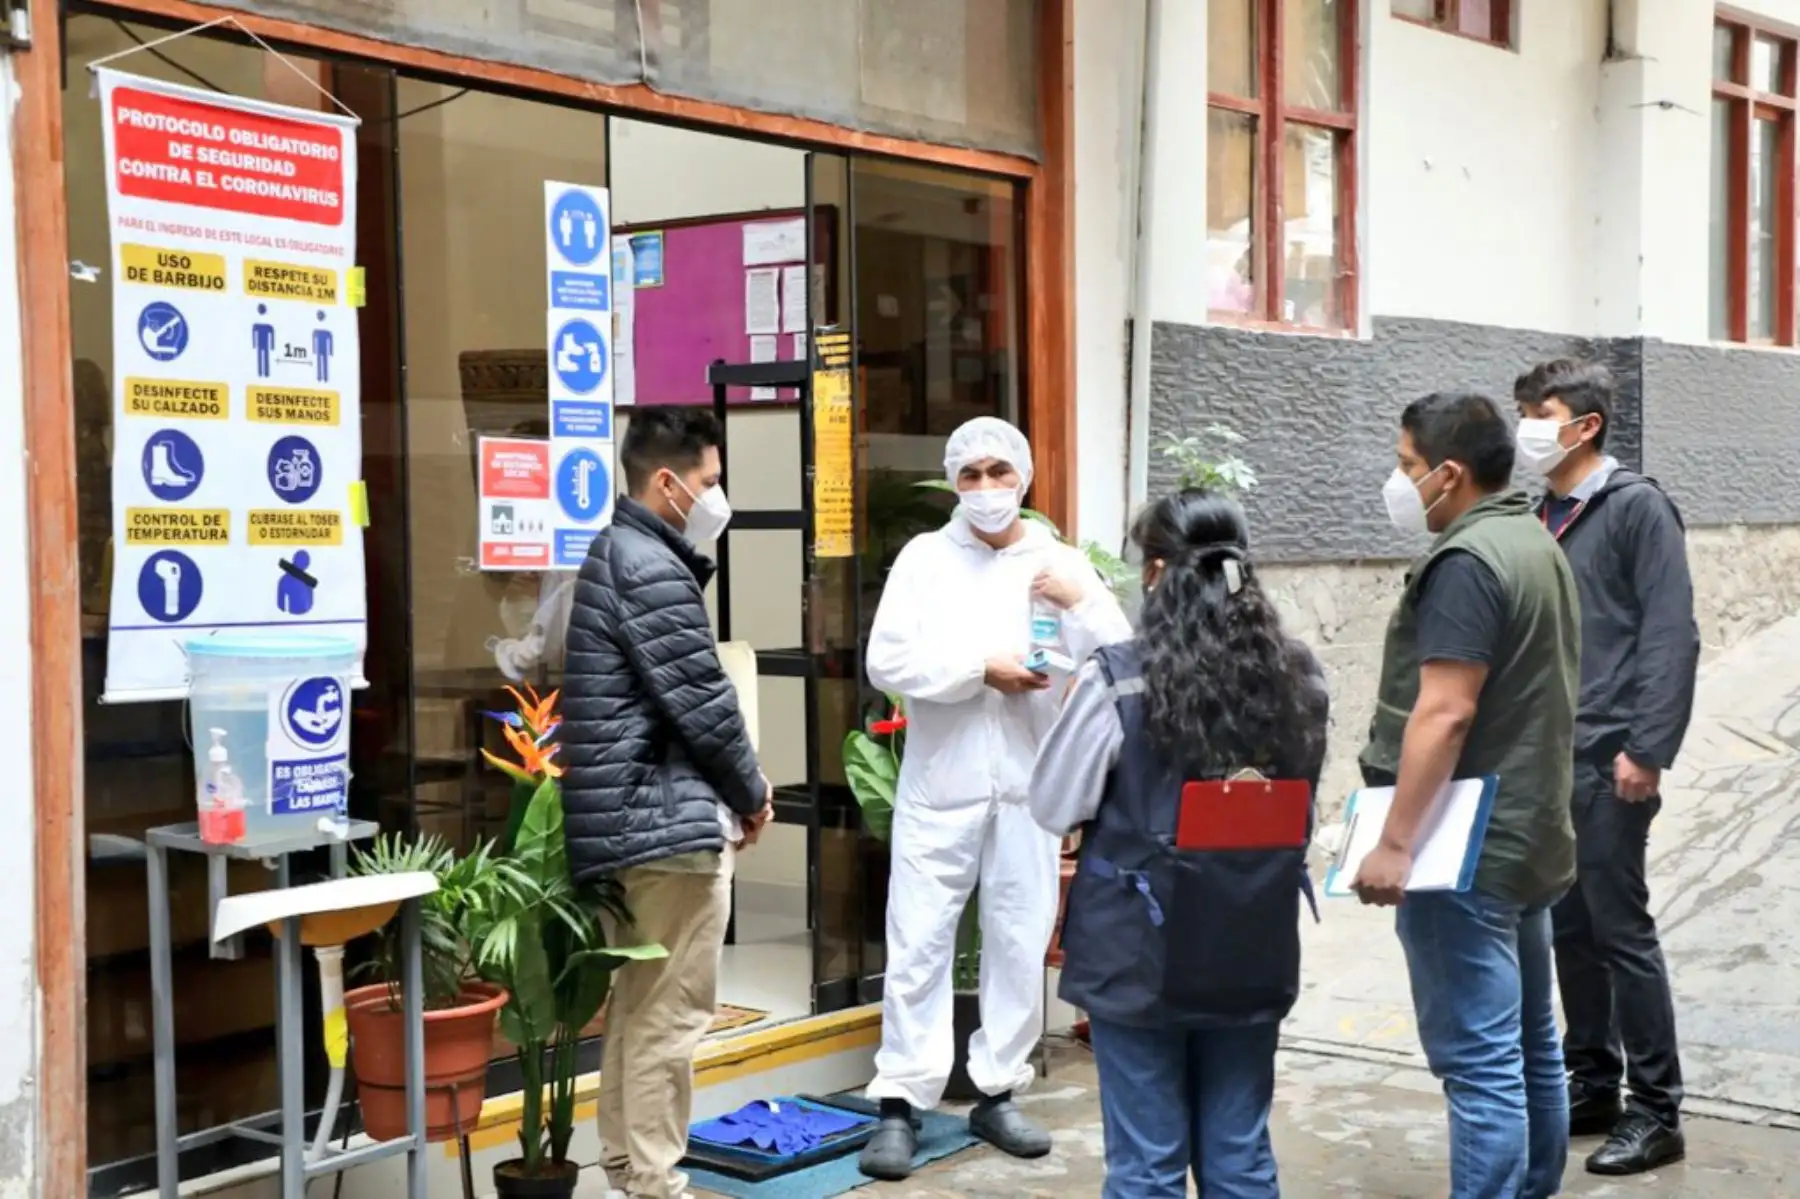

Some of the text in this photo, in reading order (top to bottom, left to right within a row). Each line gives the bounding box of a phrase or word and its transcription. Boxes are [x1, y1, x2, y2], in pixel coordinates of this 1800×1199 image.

[117, 106, 338, 160] PROTOCOLO OBLIGATORIO
[168, 141, 296, 177] DE SEGURIDAD
[119, 158, 339, 207] CONTRA EL CORONAVIRUS
[118, 216, 344, 256] PARA EL INGRESO DE ESTE LOCAL ES OBLIGATORIO
[157, 253, 191, 269] USO
[128, 266, 224, 290] DE BARBIJO
[254, 266, 328, 285] RESPETE SU
[248, 280, 335, 300] DISTANCIA 1M
[284, 343, 306, 358] 1m
[133, 384, 218, 401] DESINFECTE
[256, 392, 331, 409] DESINFECTE
[132, 398, 220, 415] SU CALZADO
[257, 407, 331, 421] SUS MANOS
[134, 514, 222, 526] CONTROL DE
[251, 513, 339, 525] CUBRASE AL TOSER
[128, 527, 228, 540] TEMPERATURA
[260, 528, 331, 539] O ESTORNUDAR
[276, 766, 290, 779] ES
[289, 796, 311, 809] LAS
